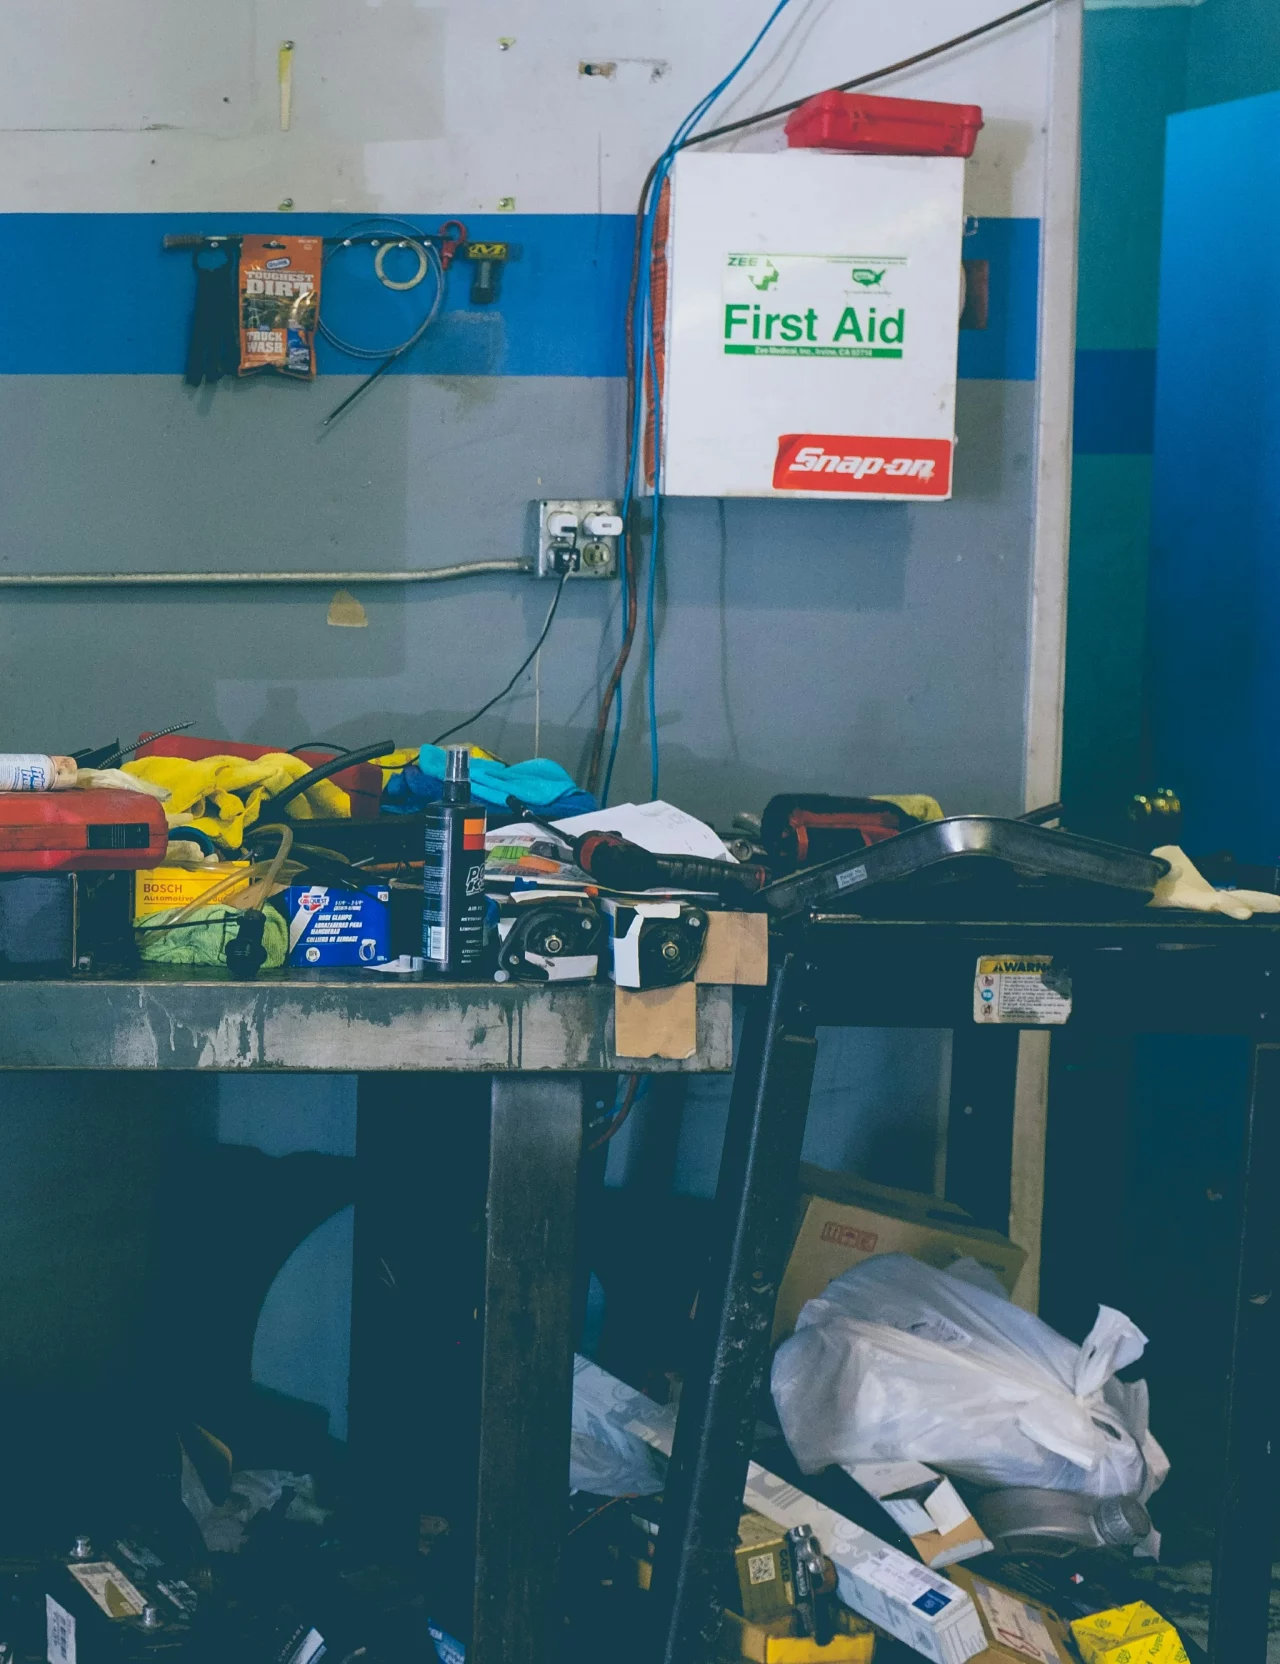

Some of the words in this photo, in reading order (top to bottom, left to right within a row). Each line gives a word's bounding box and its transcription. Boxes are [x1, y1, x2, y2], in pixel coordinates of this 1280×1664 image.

[246, 271, 314, 281] TOUGHEST
[247, 279, 314, 297] DIRT
[724, 304, 818, 341] First
[832, 307, 905, 343] Aid
[247, 332, 282, 342] TRUCK
[247, 342, 283, 353] WASH
[789, 447, 936, 479] Snap-on
[144, 884, 182, 893] BOSCH
